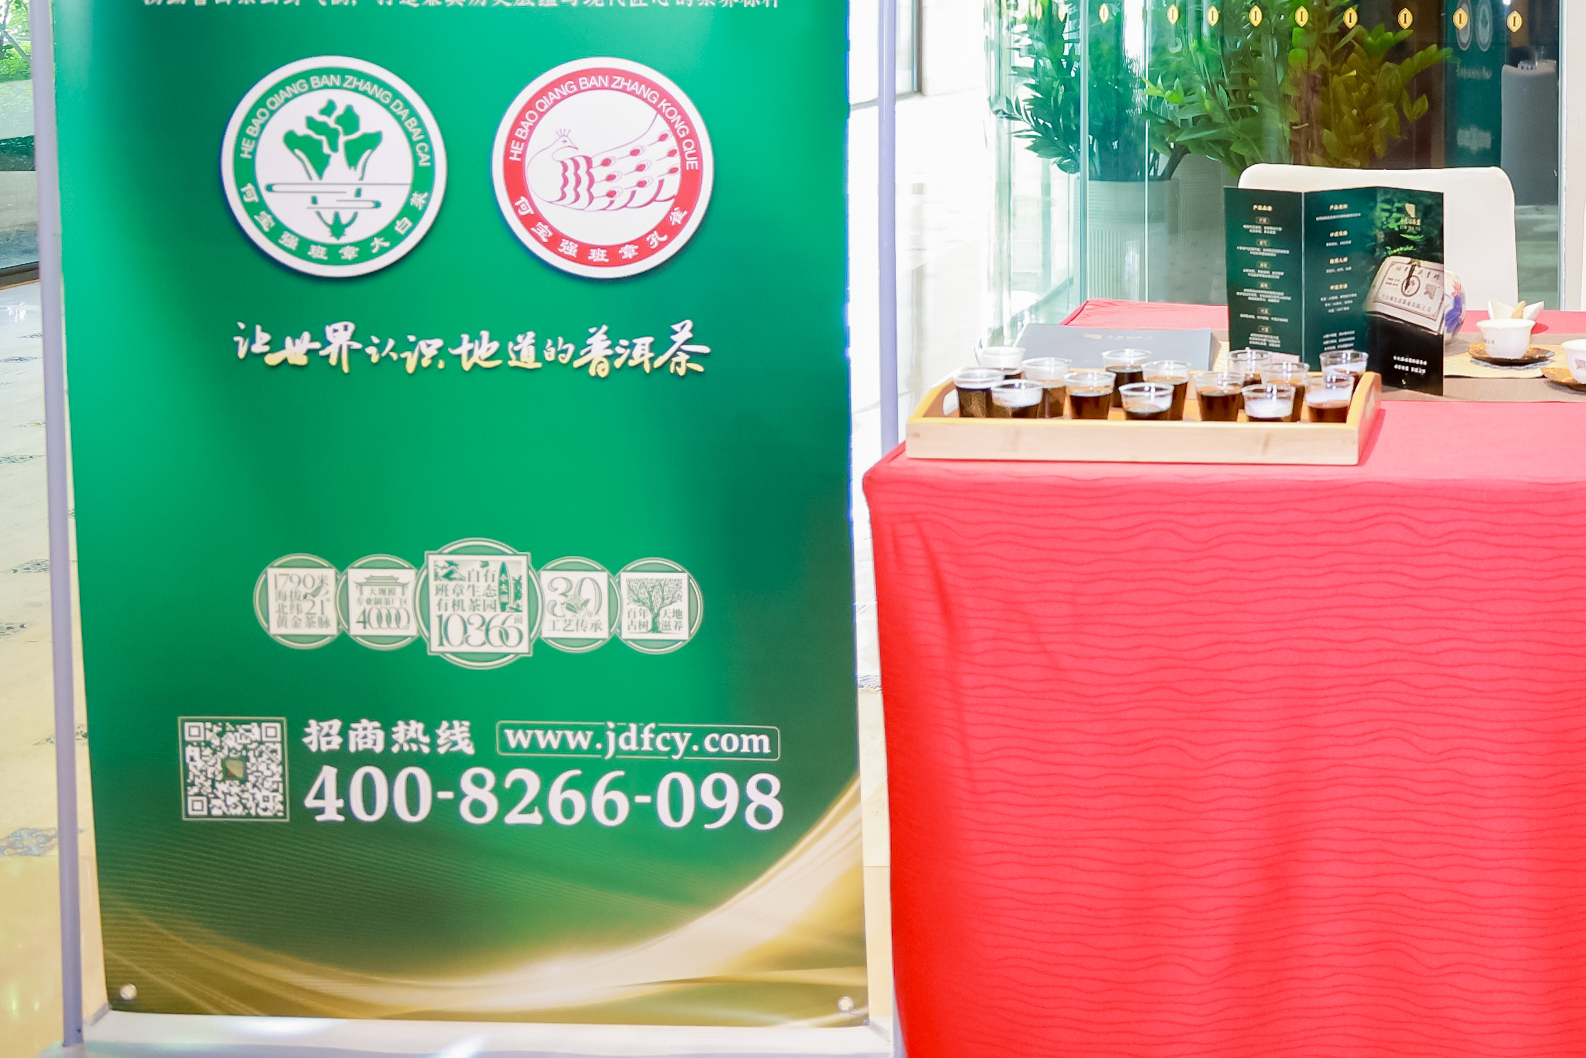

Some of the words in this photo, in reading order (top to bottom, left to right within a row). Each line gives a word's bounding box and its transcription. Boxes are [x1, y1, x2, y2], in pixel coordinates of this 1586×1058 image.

[265, 77, 310, 112] QIANG
[309, 74, 342, 91] BAN
[342, 74, 394, 104] ZHANG
[534, 79, 578, 114] QIANG
[577, 74, 610, 91] BAN
[611, 74, 661, 105] ZHANG
[245, 104, 270, 139] BAO
[389, 97, 409, 124] DA
[515, 109, 540, 140] BAO
[656, 98, 692, 139] KONG
[403, 117, 426, 142] BAI
[239, 137, 255, 160] HE
[415, 143, 432, 168] CAI
[508, 139, 525, 163] HE
[681, 139, 700, 172] QUE
[240, 182, 429, 262] 何宝强班章大白菜
[514, 195, 688, 264] 何宝强班章孔雀
[233, 317, 711, 379] 让世界认识地道的普洱茶
[434, 583, 497, 598] 班章生态
[436, 598, 497, 613] 有机茶园
[547, 618, 604, 634] 工艺传承
[301, 718, 476, 757] 招商热线
[504, 722, 772, 760] www.jdfcy.com
[302, 764, 785, 831] 400-8266-098
